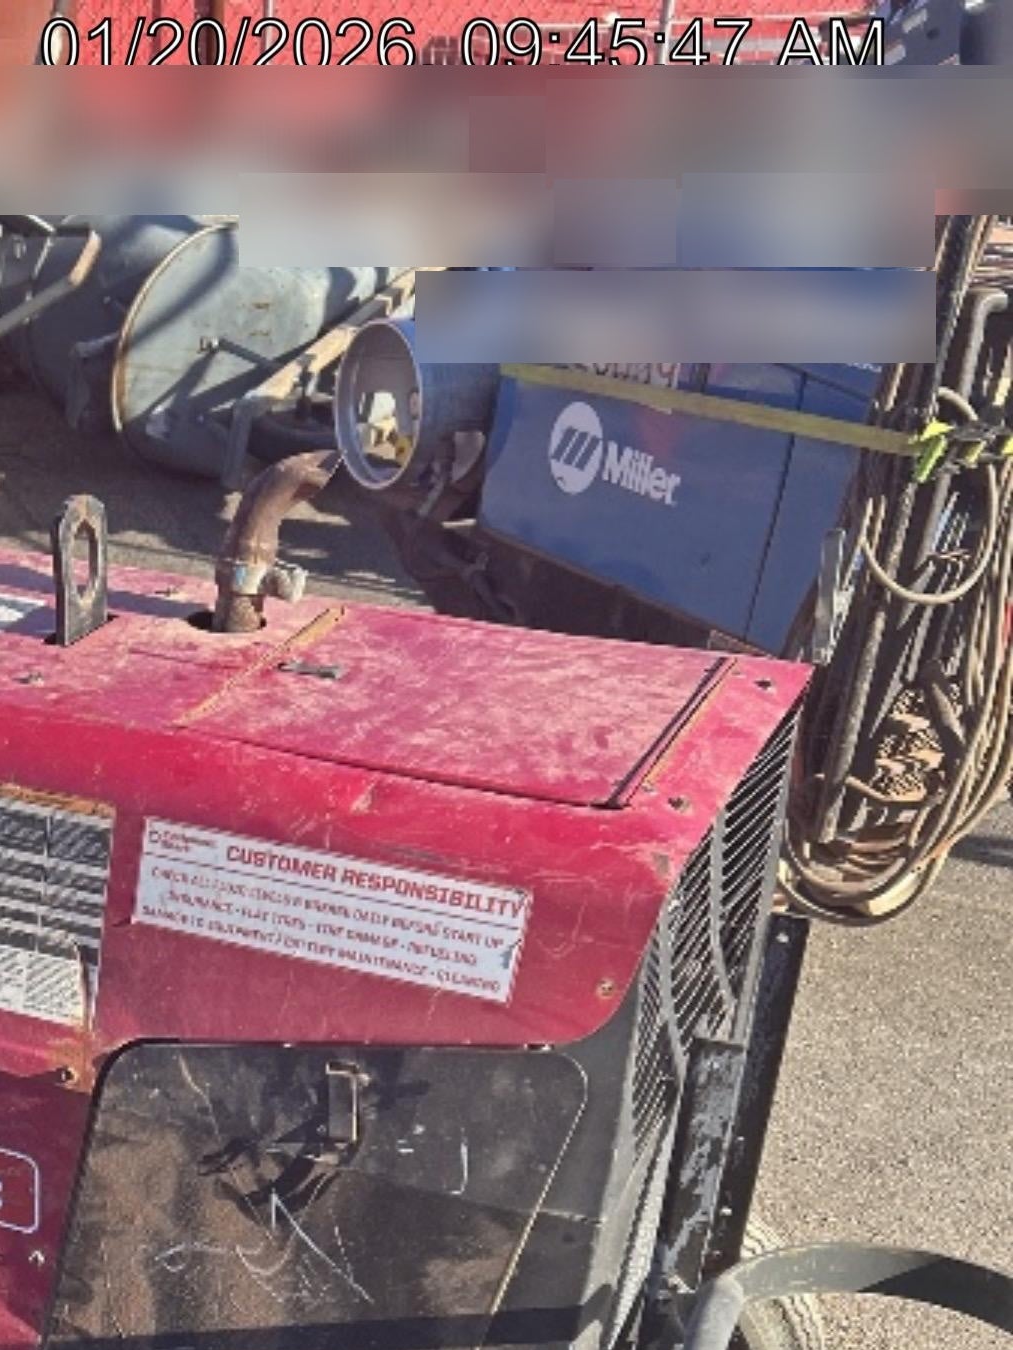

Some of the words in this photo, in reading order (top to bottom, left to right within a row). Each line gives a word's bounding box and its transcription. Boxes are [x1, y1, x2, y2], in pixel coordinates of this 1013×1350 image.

[602, 440, 681, 505] Miller
[226, 845, 337, 884] CUSTOMER
[340, 867, 526, 919] RESPONSIBILITY
